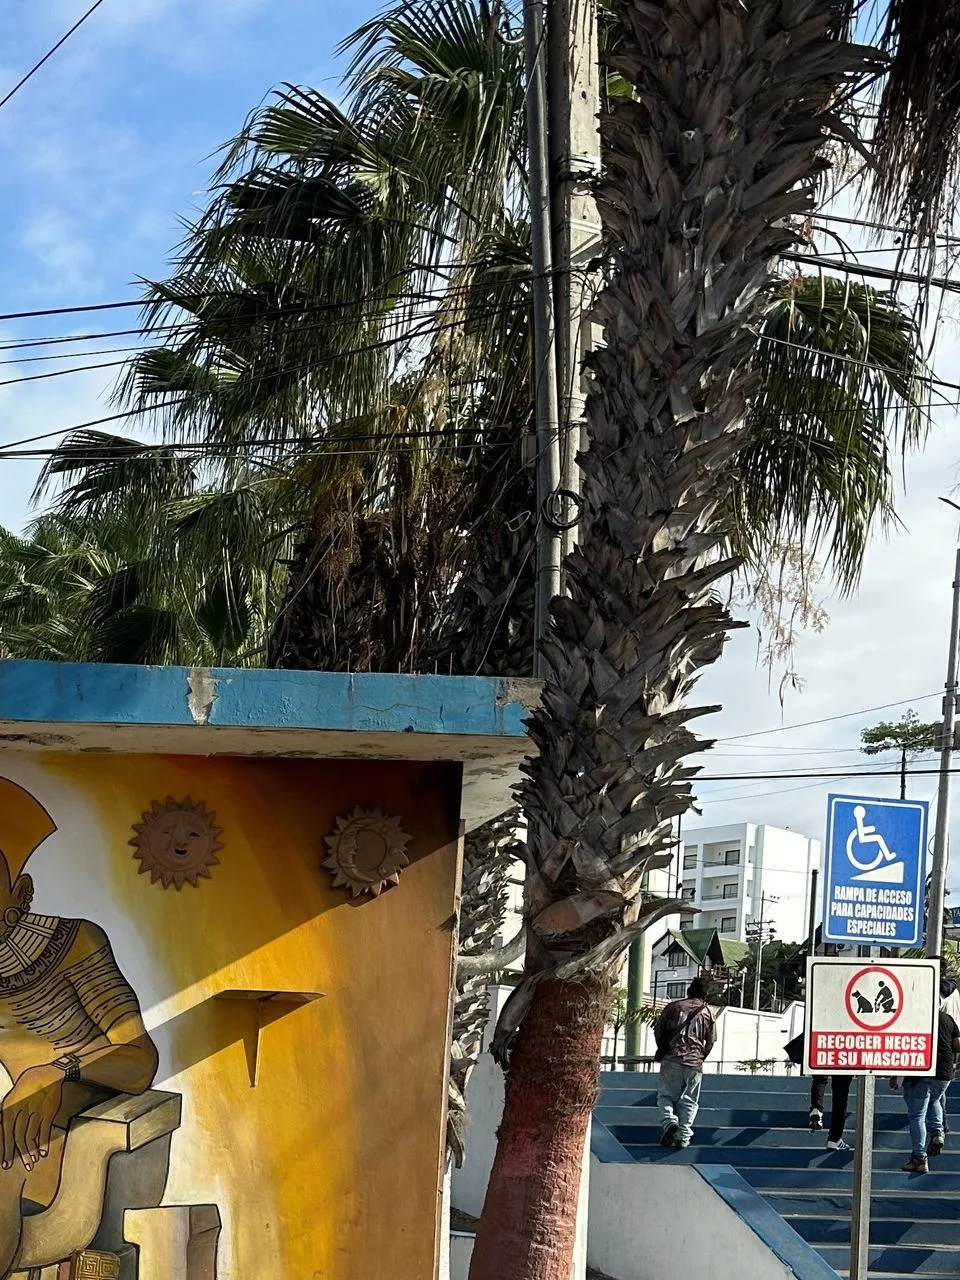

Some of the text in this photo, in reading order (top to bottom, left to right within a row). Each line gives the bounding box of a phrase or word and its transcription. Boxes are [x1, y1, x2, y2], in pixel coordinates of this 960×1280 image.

[834, 885, 913, 906] RAMPA DE ACCESO
[831, 901, 914, 922] PARA CAPACIDADES
[846, 919, 897, 937] ESPECIALES
[816, 1034, 927, 1051] RECOGER HECES
[816, 1051, 926, 1067] DE SU MASCOTA
